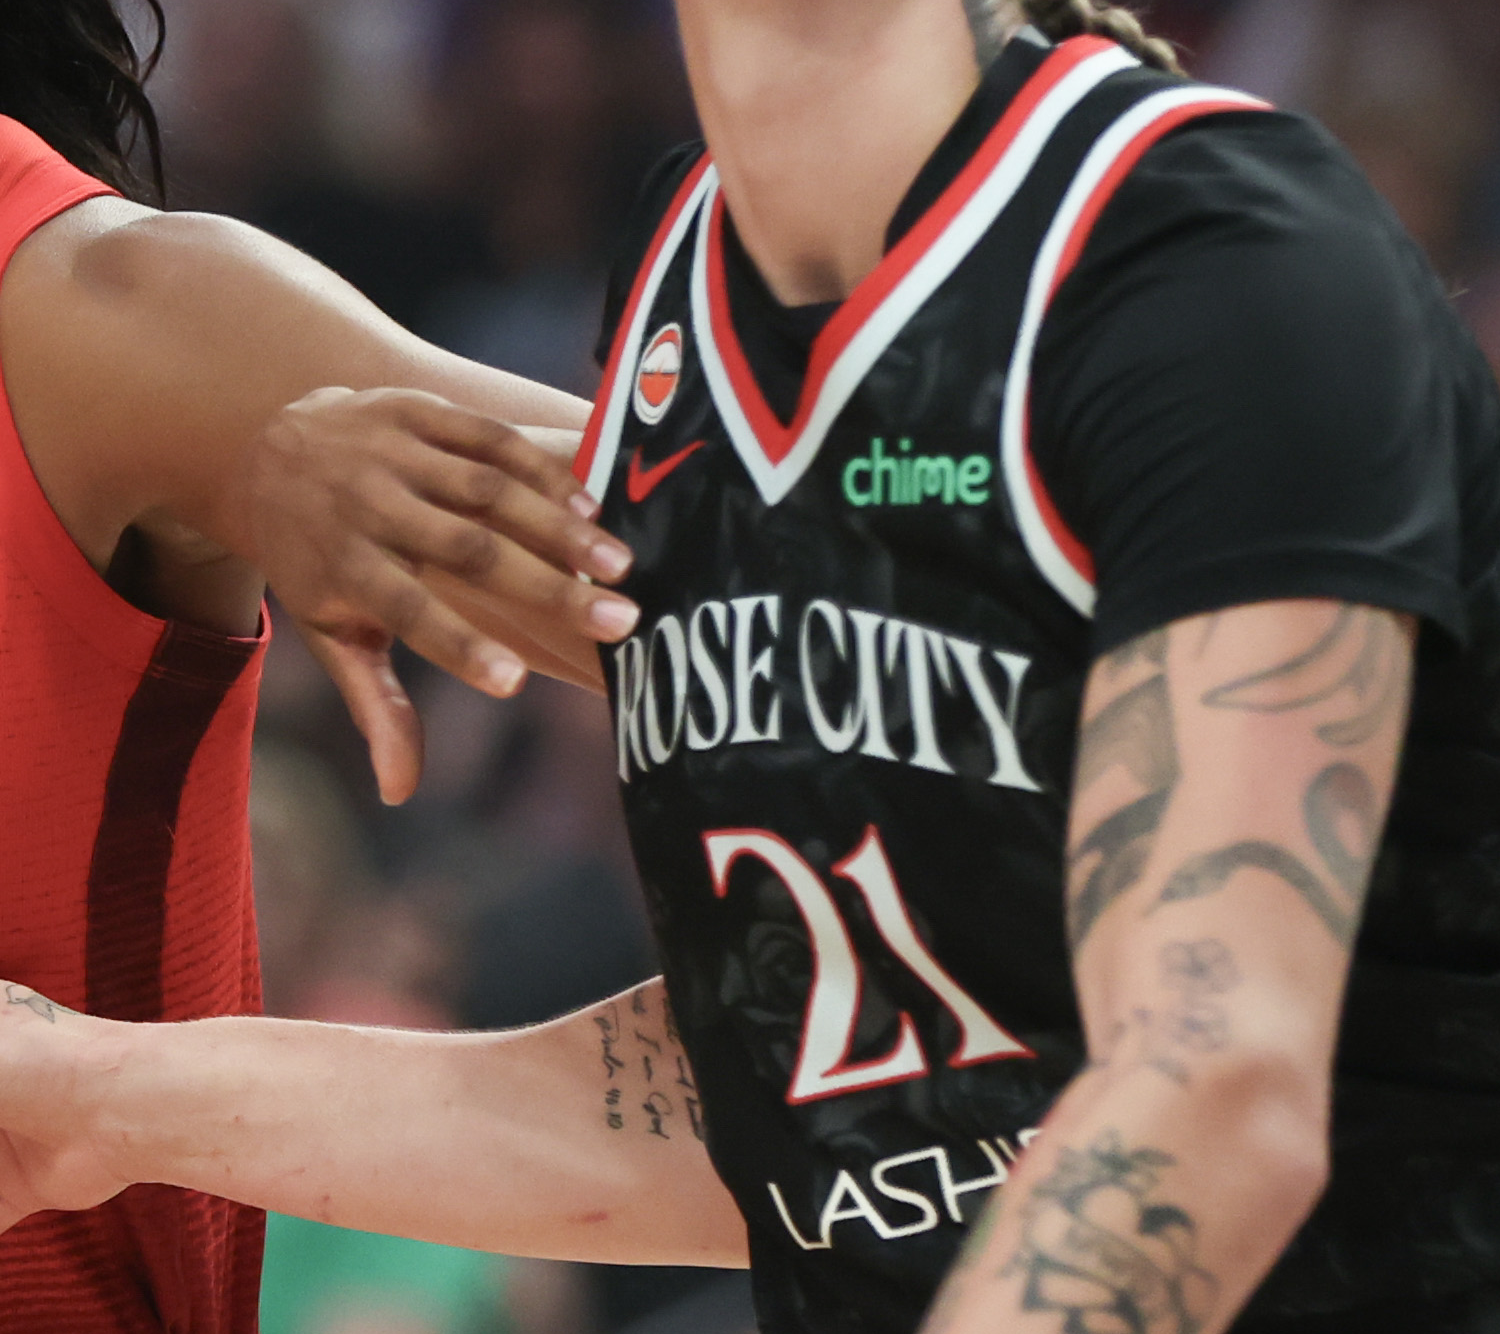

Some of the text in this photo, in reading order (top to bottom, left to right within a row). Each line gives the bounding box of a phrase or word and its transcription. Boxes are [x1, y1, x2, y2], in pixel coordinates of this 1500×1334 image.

[841, 438, 991, 506] chime
[615, 595, 1043, 792] ROSE CITY
[703, 823, 1038, 1106] 21
[767, 1128, 1043, 1249] LASH
